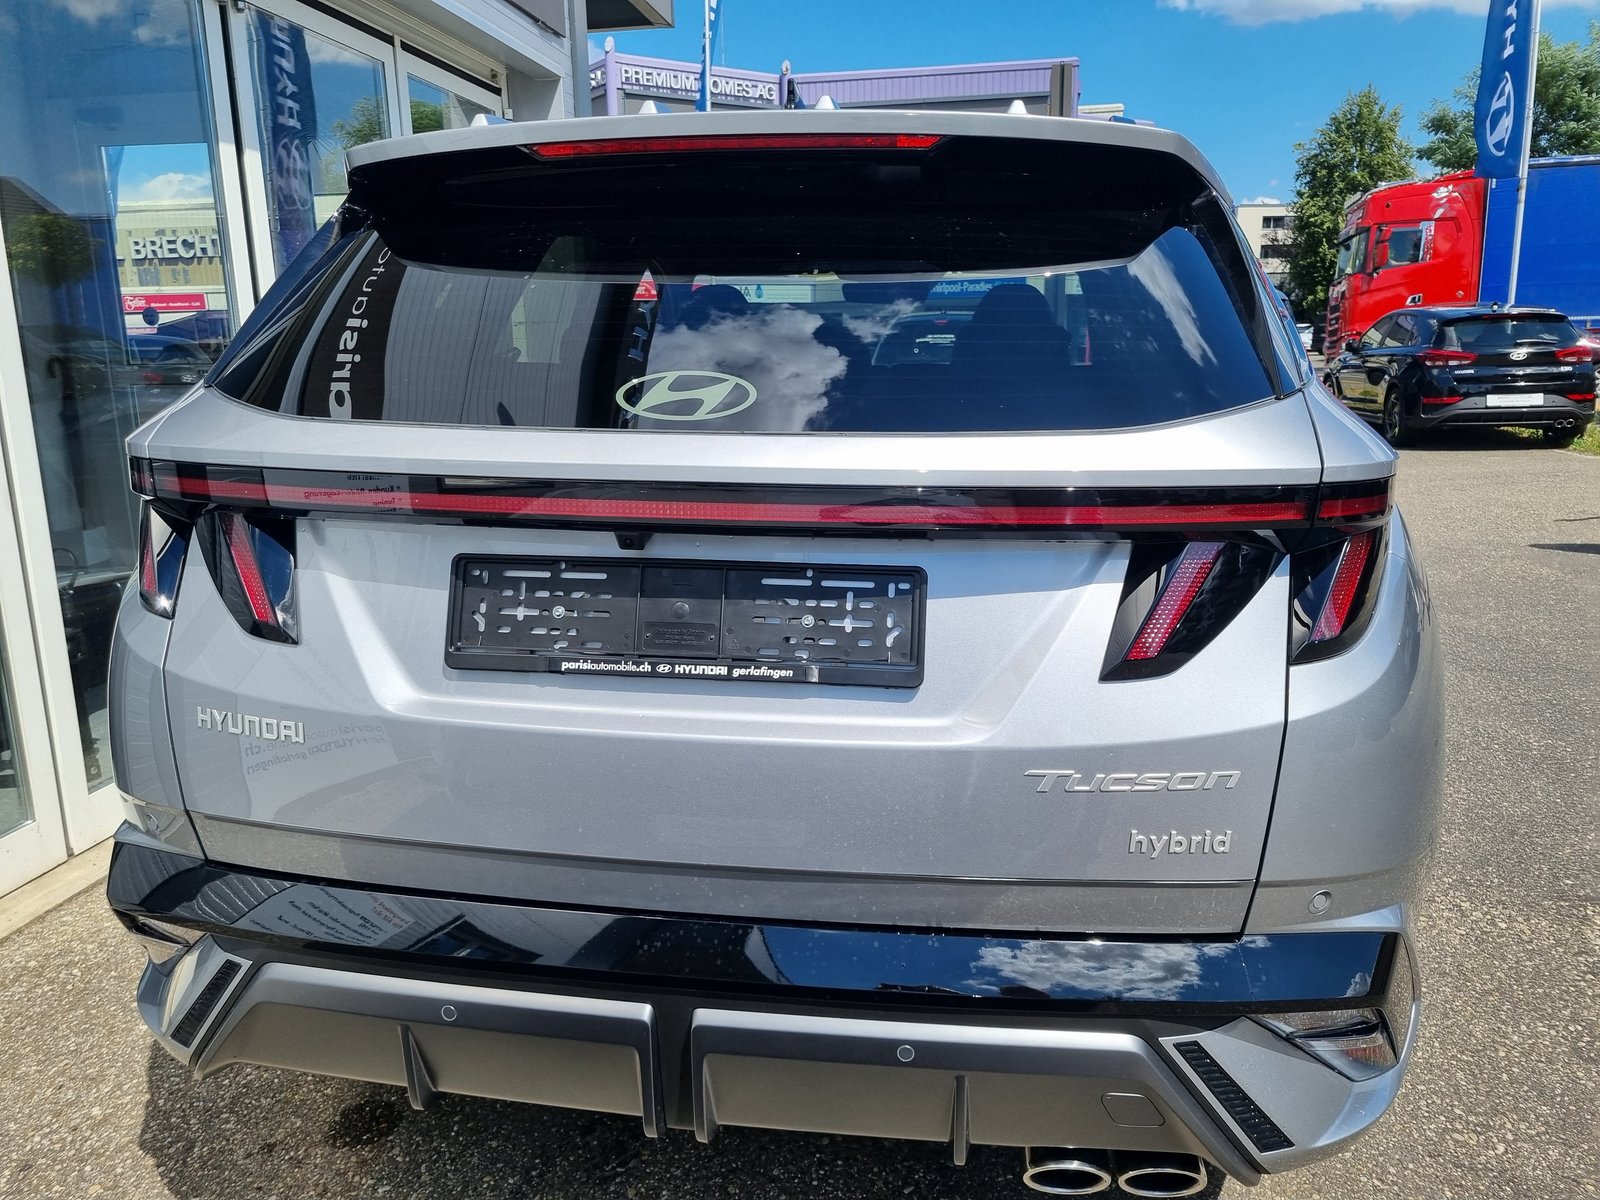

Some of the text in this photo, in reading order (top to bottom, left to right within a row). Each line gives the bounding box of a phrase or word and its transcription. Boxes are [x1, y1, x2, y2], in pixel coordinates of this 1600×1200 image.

[621, 67, 776, 100] PREMIUM OMES AG
[561, 660, 793, 678] parisiautomobile.ch HYUNDAI gerlafingen
[197, 706, 306, 744] HYUNDAI
[1128, 829, 1232, 859] hybrid
